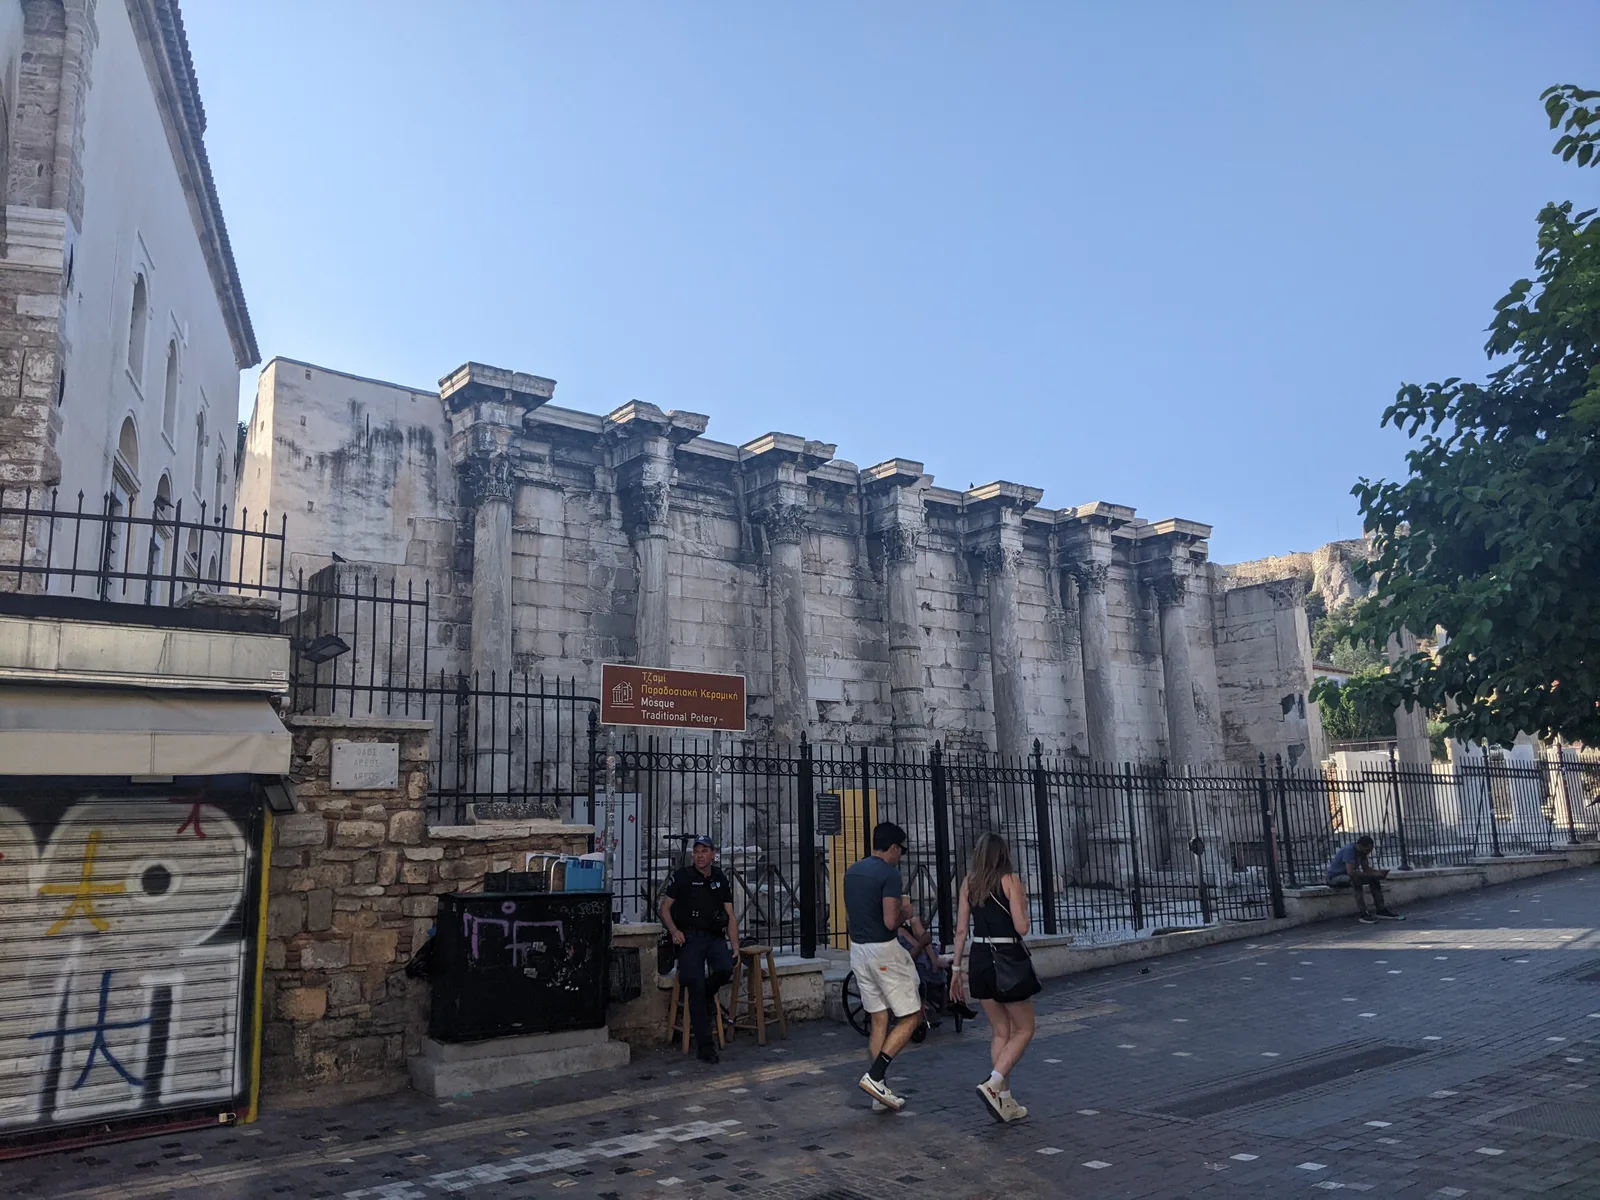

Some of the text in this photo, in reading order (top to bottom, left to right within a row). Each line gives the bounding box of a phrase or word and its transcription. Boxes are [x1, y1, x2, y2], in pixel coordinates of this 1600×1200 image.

[641, 671, 667, 684] Τζαμί
[641, 684, 738, 701] Παραδοσιακή Κεραμική
[641, 697, 675, 709] Mosque
[641, 709, 718, 725] Traditional Potery
